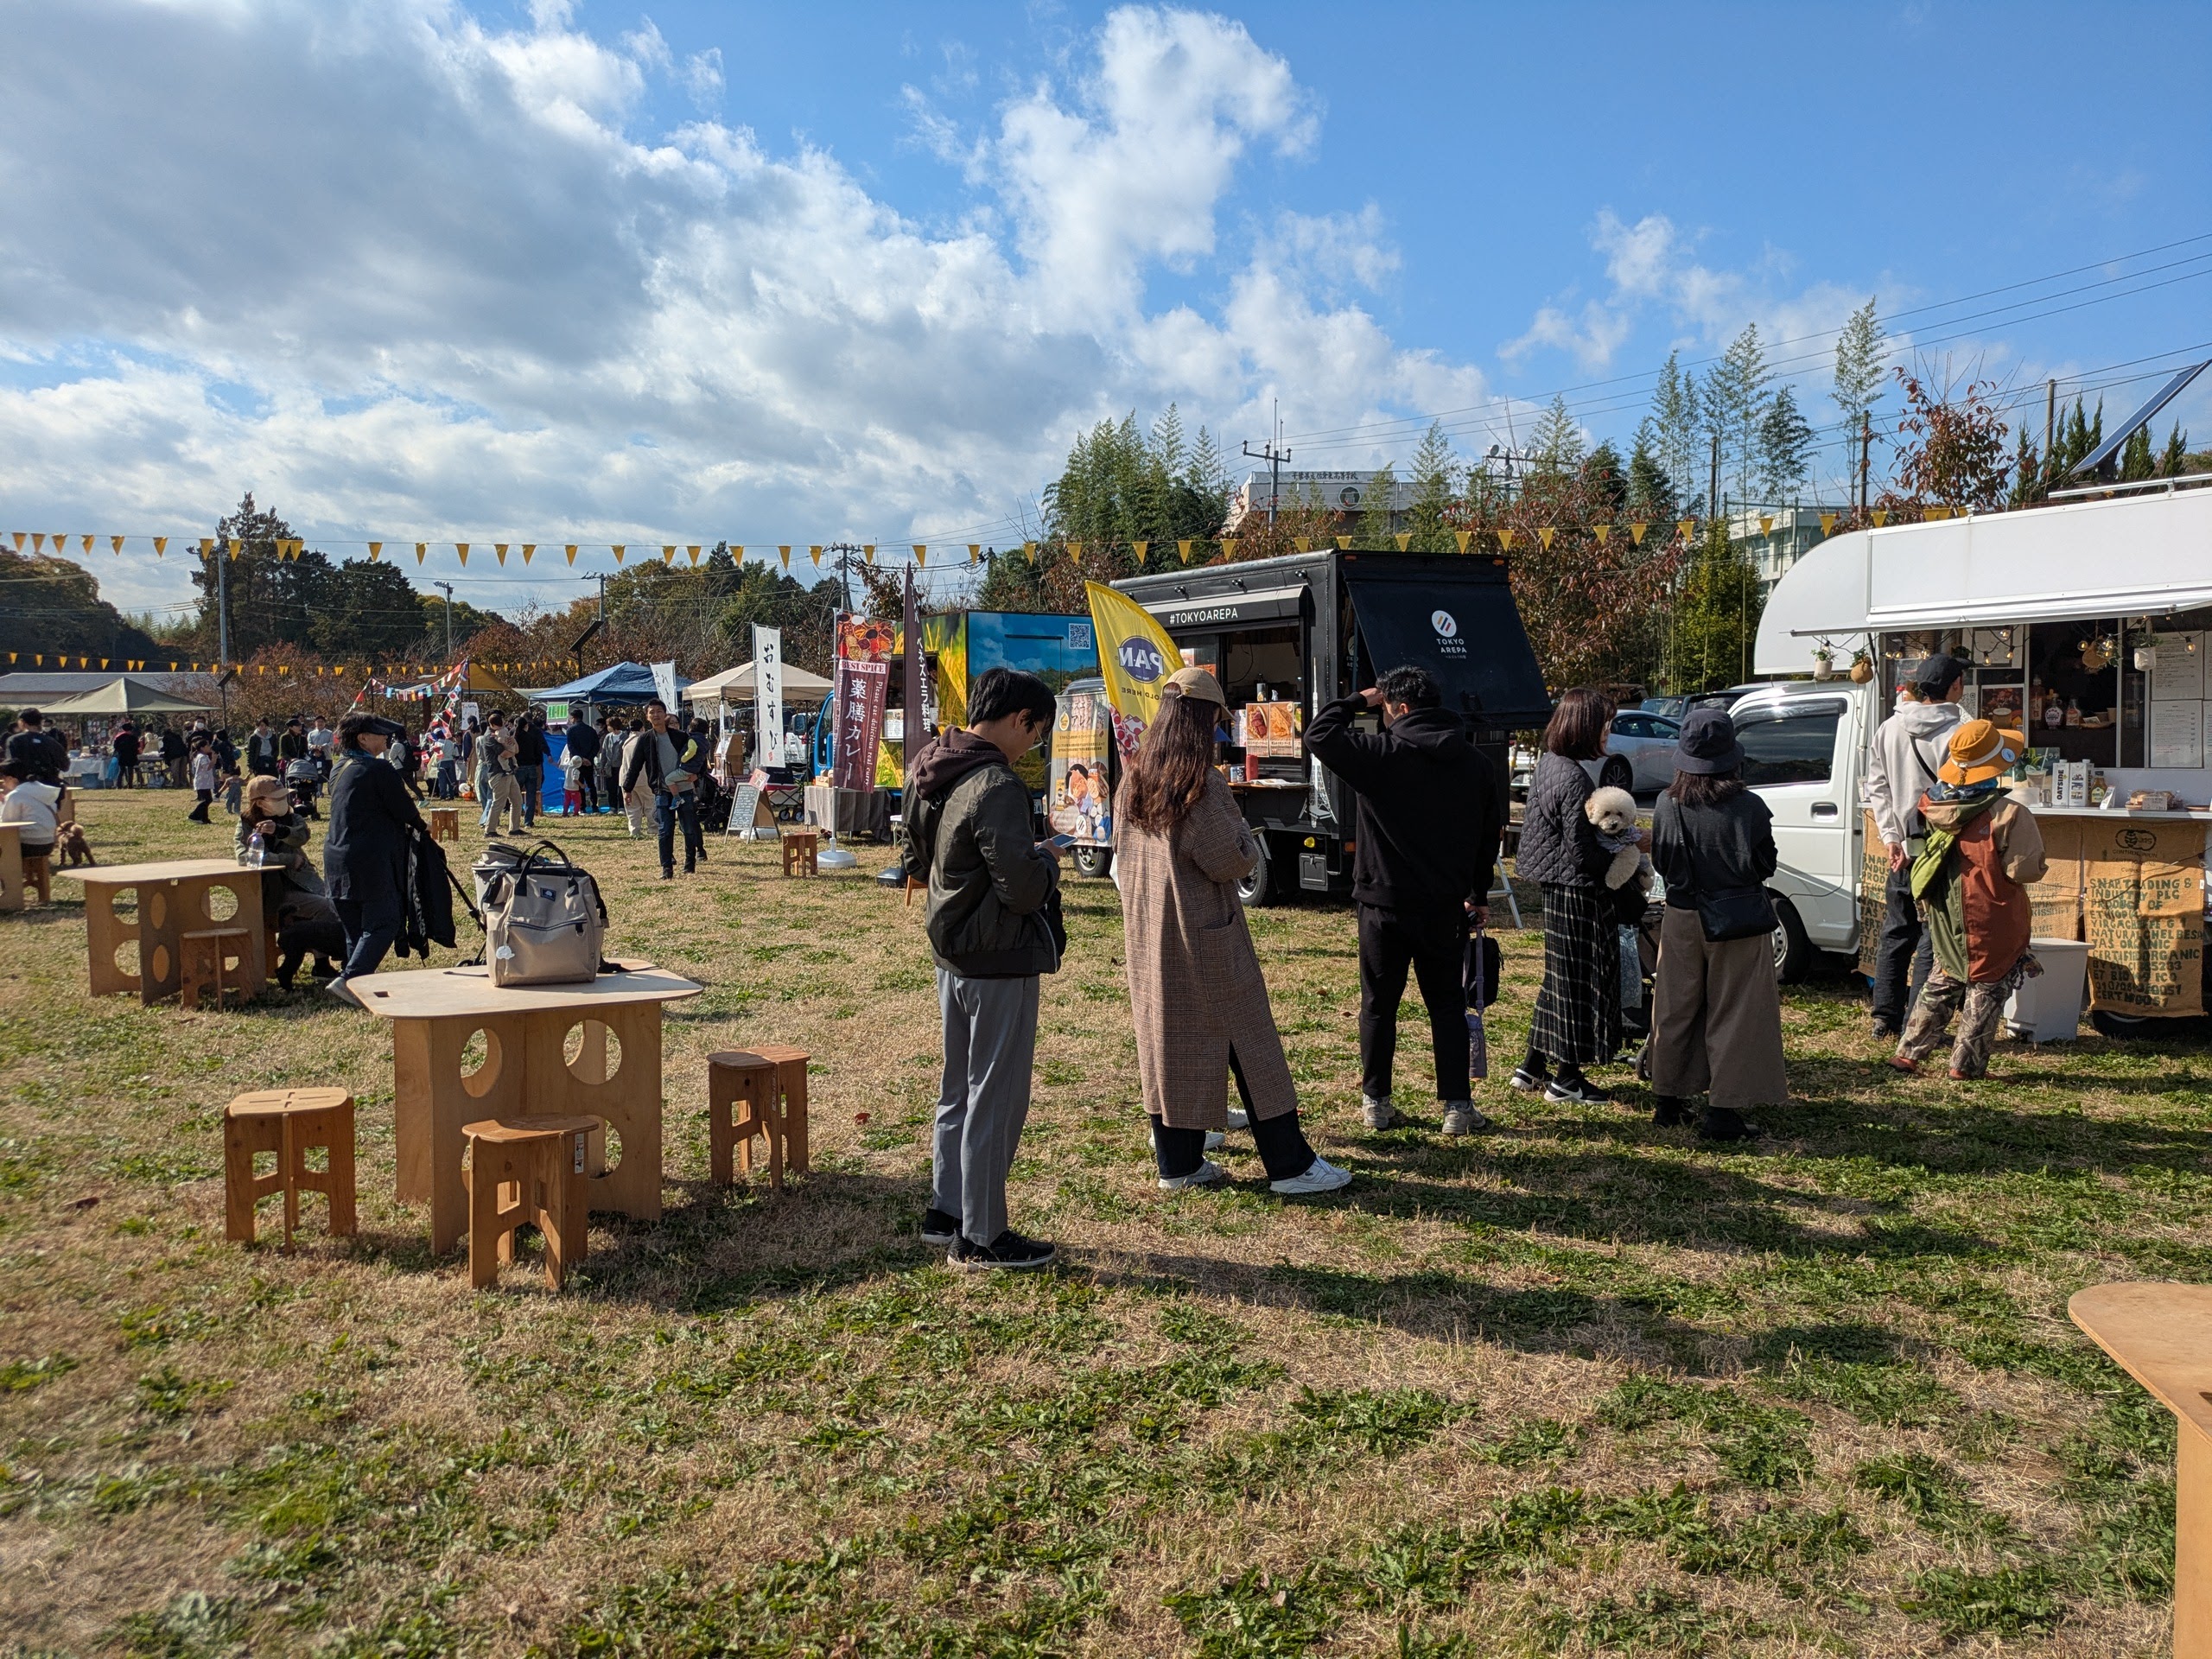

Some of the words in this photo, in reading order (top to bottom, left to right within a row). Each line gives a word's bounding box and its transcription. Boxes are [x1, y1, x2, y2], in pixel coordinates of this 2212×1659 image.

[1170, 607, 1238, 625] #TOKYOAREPA
[842, 660, 860, 671] BEST
[861, 662, 884, 673] SPICE
[917, 636, 931, 733] ベネズエラ料理
[845, 677, 867, 780] 薬膳カレー
[2123, 879, 2180, 889] TADING
[2091, 899, 2139, 910] PRODUC
